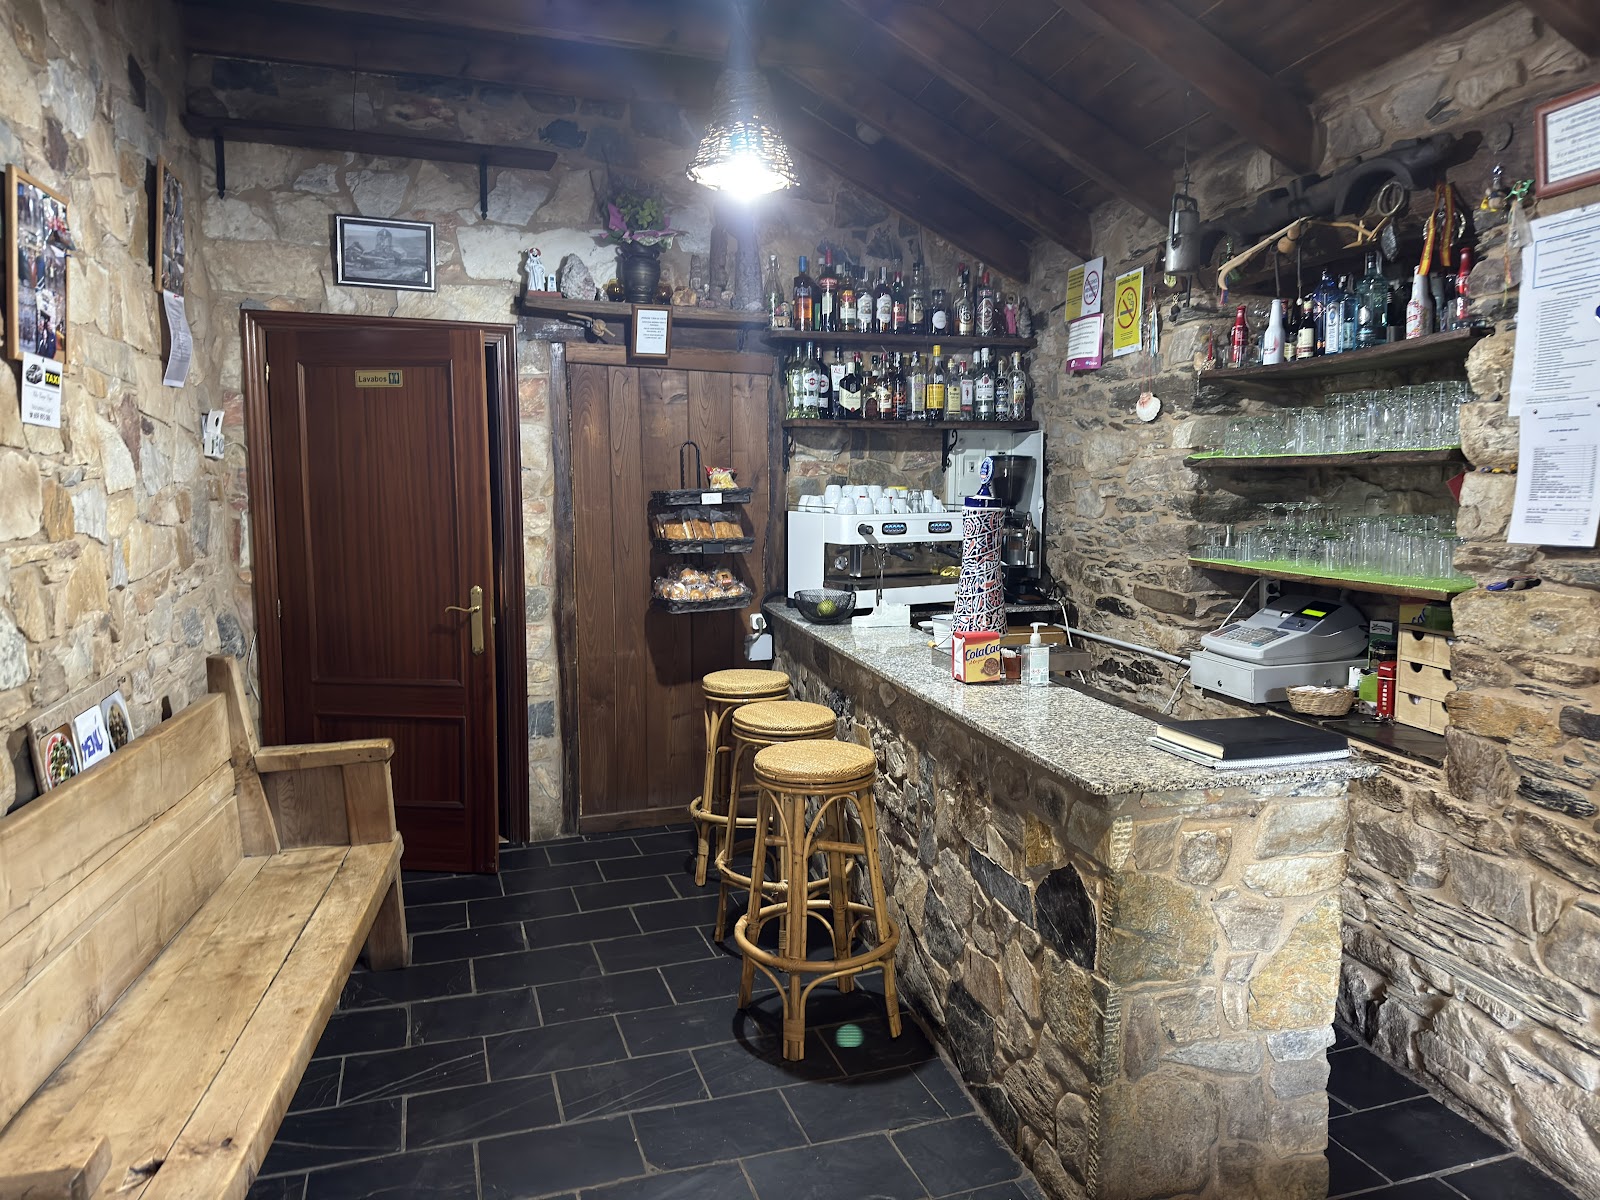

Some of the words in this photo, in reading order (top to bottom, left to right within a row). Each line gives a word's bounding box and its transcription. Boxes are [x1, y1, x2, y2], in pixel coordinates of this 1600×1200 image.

[45, 372, 60, 385] TAXI
[358, 375, 387, 383] Lavabos
[965, 643, 1001, 661] ColaCao
